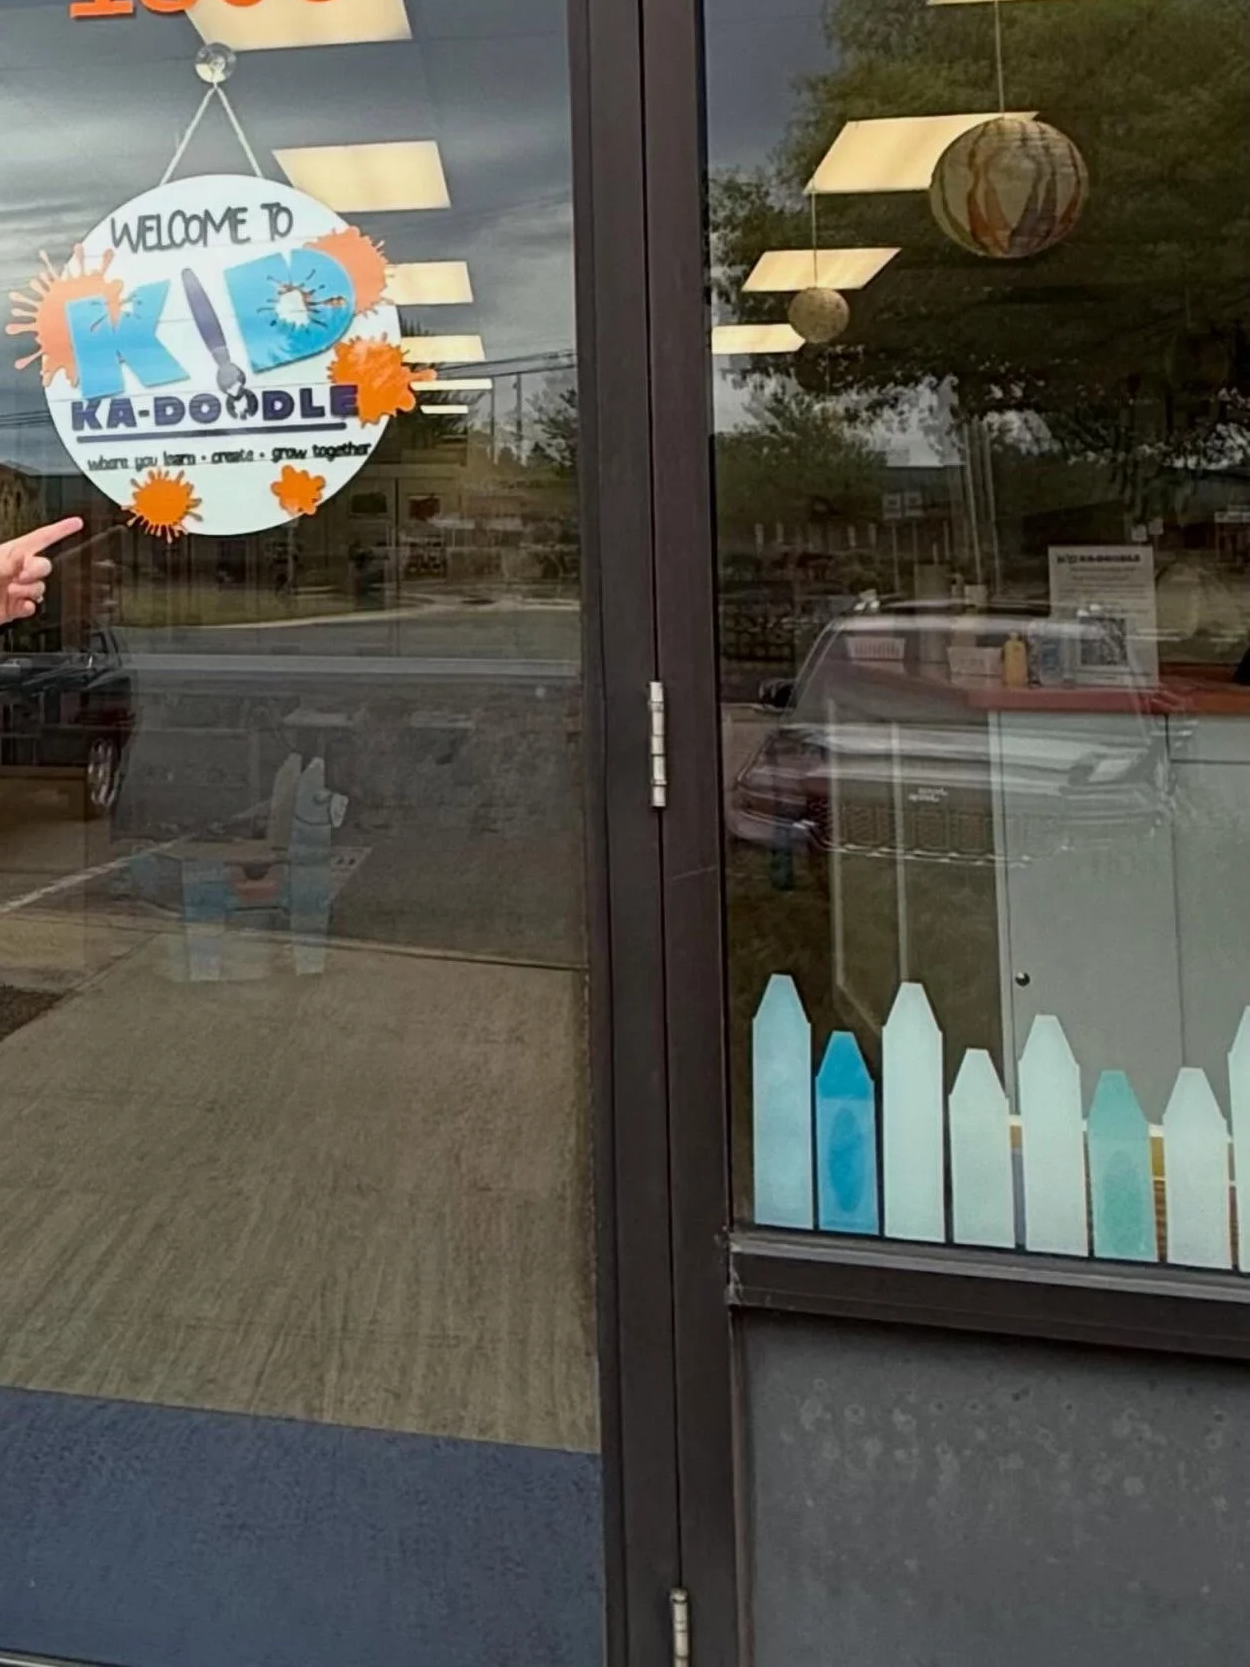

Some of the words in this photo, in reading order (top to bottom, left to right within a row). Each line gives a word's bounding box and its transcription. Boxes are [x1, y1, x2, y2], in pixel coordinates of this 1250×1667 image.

[110, 205, 250, 253] WELCOME
[261, 202, 294, 242] TO
[71, 384, 360, 431] KA-DOODLE
[88, 454, 128, 471] where
[135, 455, 158, 472] you
[163, 451, 196, 466] learn
[211, 449, 254, 465] create
[271, 447, 308, 463] grow
[312, 443, 372, 462] together
